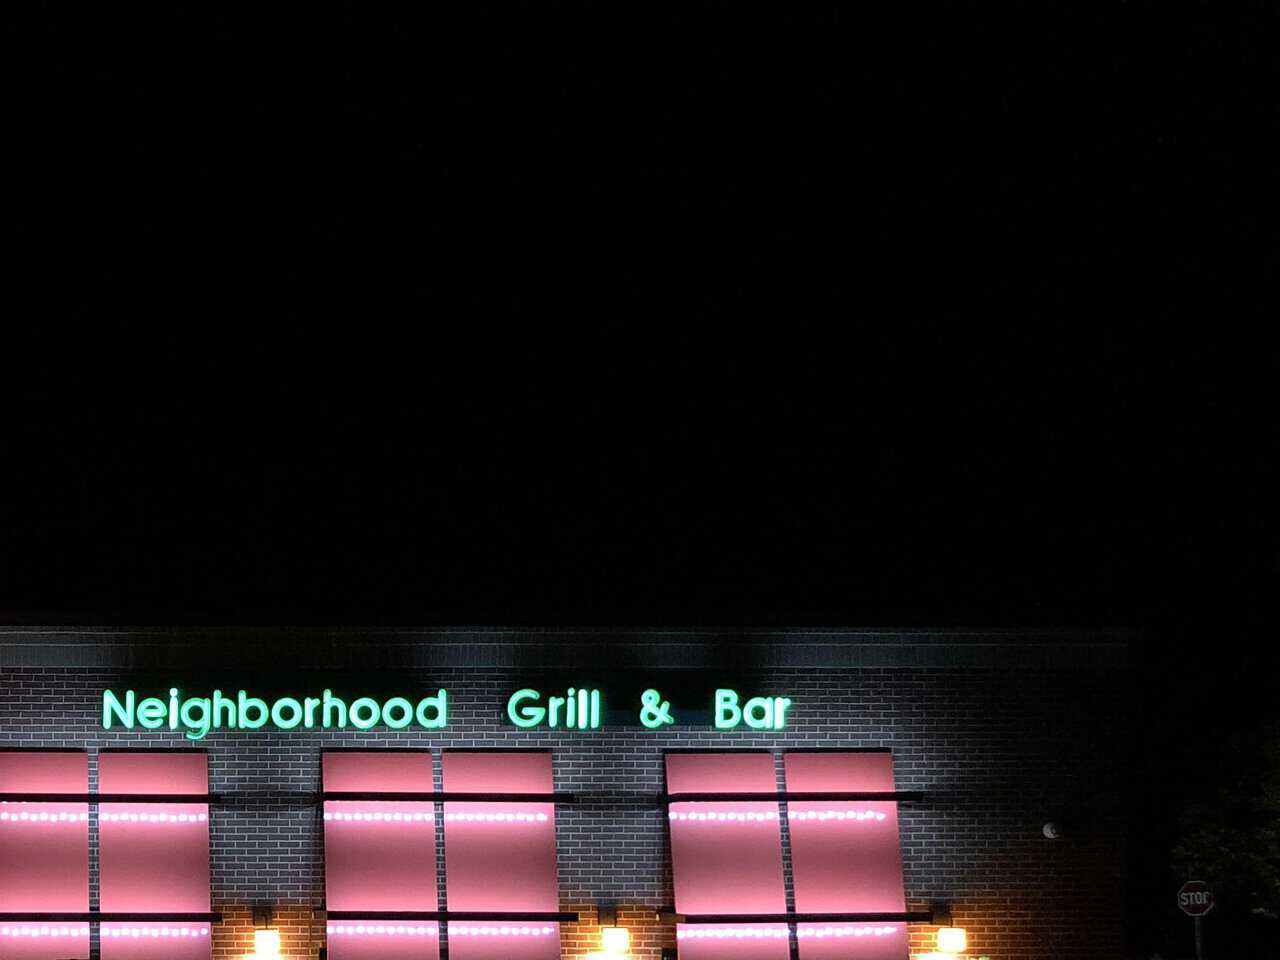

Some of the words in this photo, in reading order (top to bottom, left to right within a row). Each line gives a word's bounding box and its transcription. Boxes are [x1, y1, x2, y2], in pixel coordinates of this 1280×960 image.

[102, 687, 448, 740] Neighborhood
[507, 687, 601, 729] Grill
[639, 688, 674, 728] &
[715, 688, 792, 729] Bar
[1180, 891, 1210, 905] STOP
